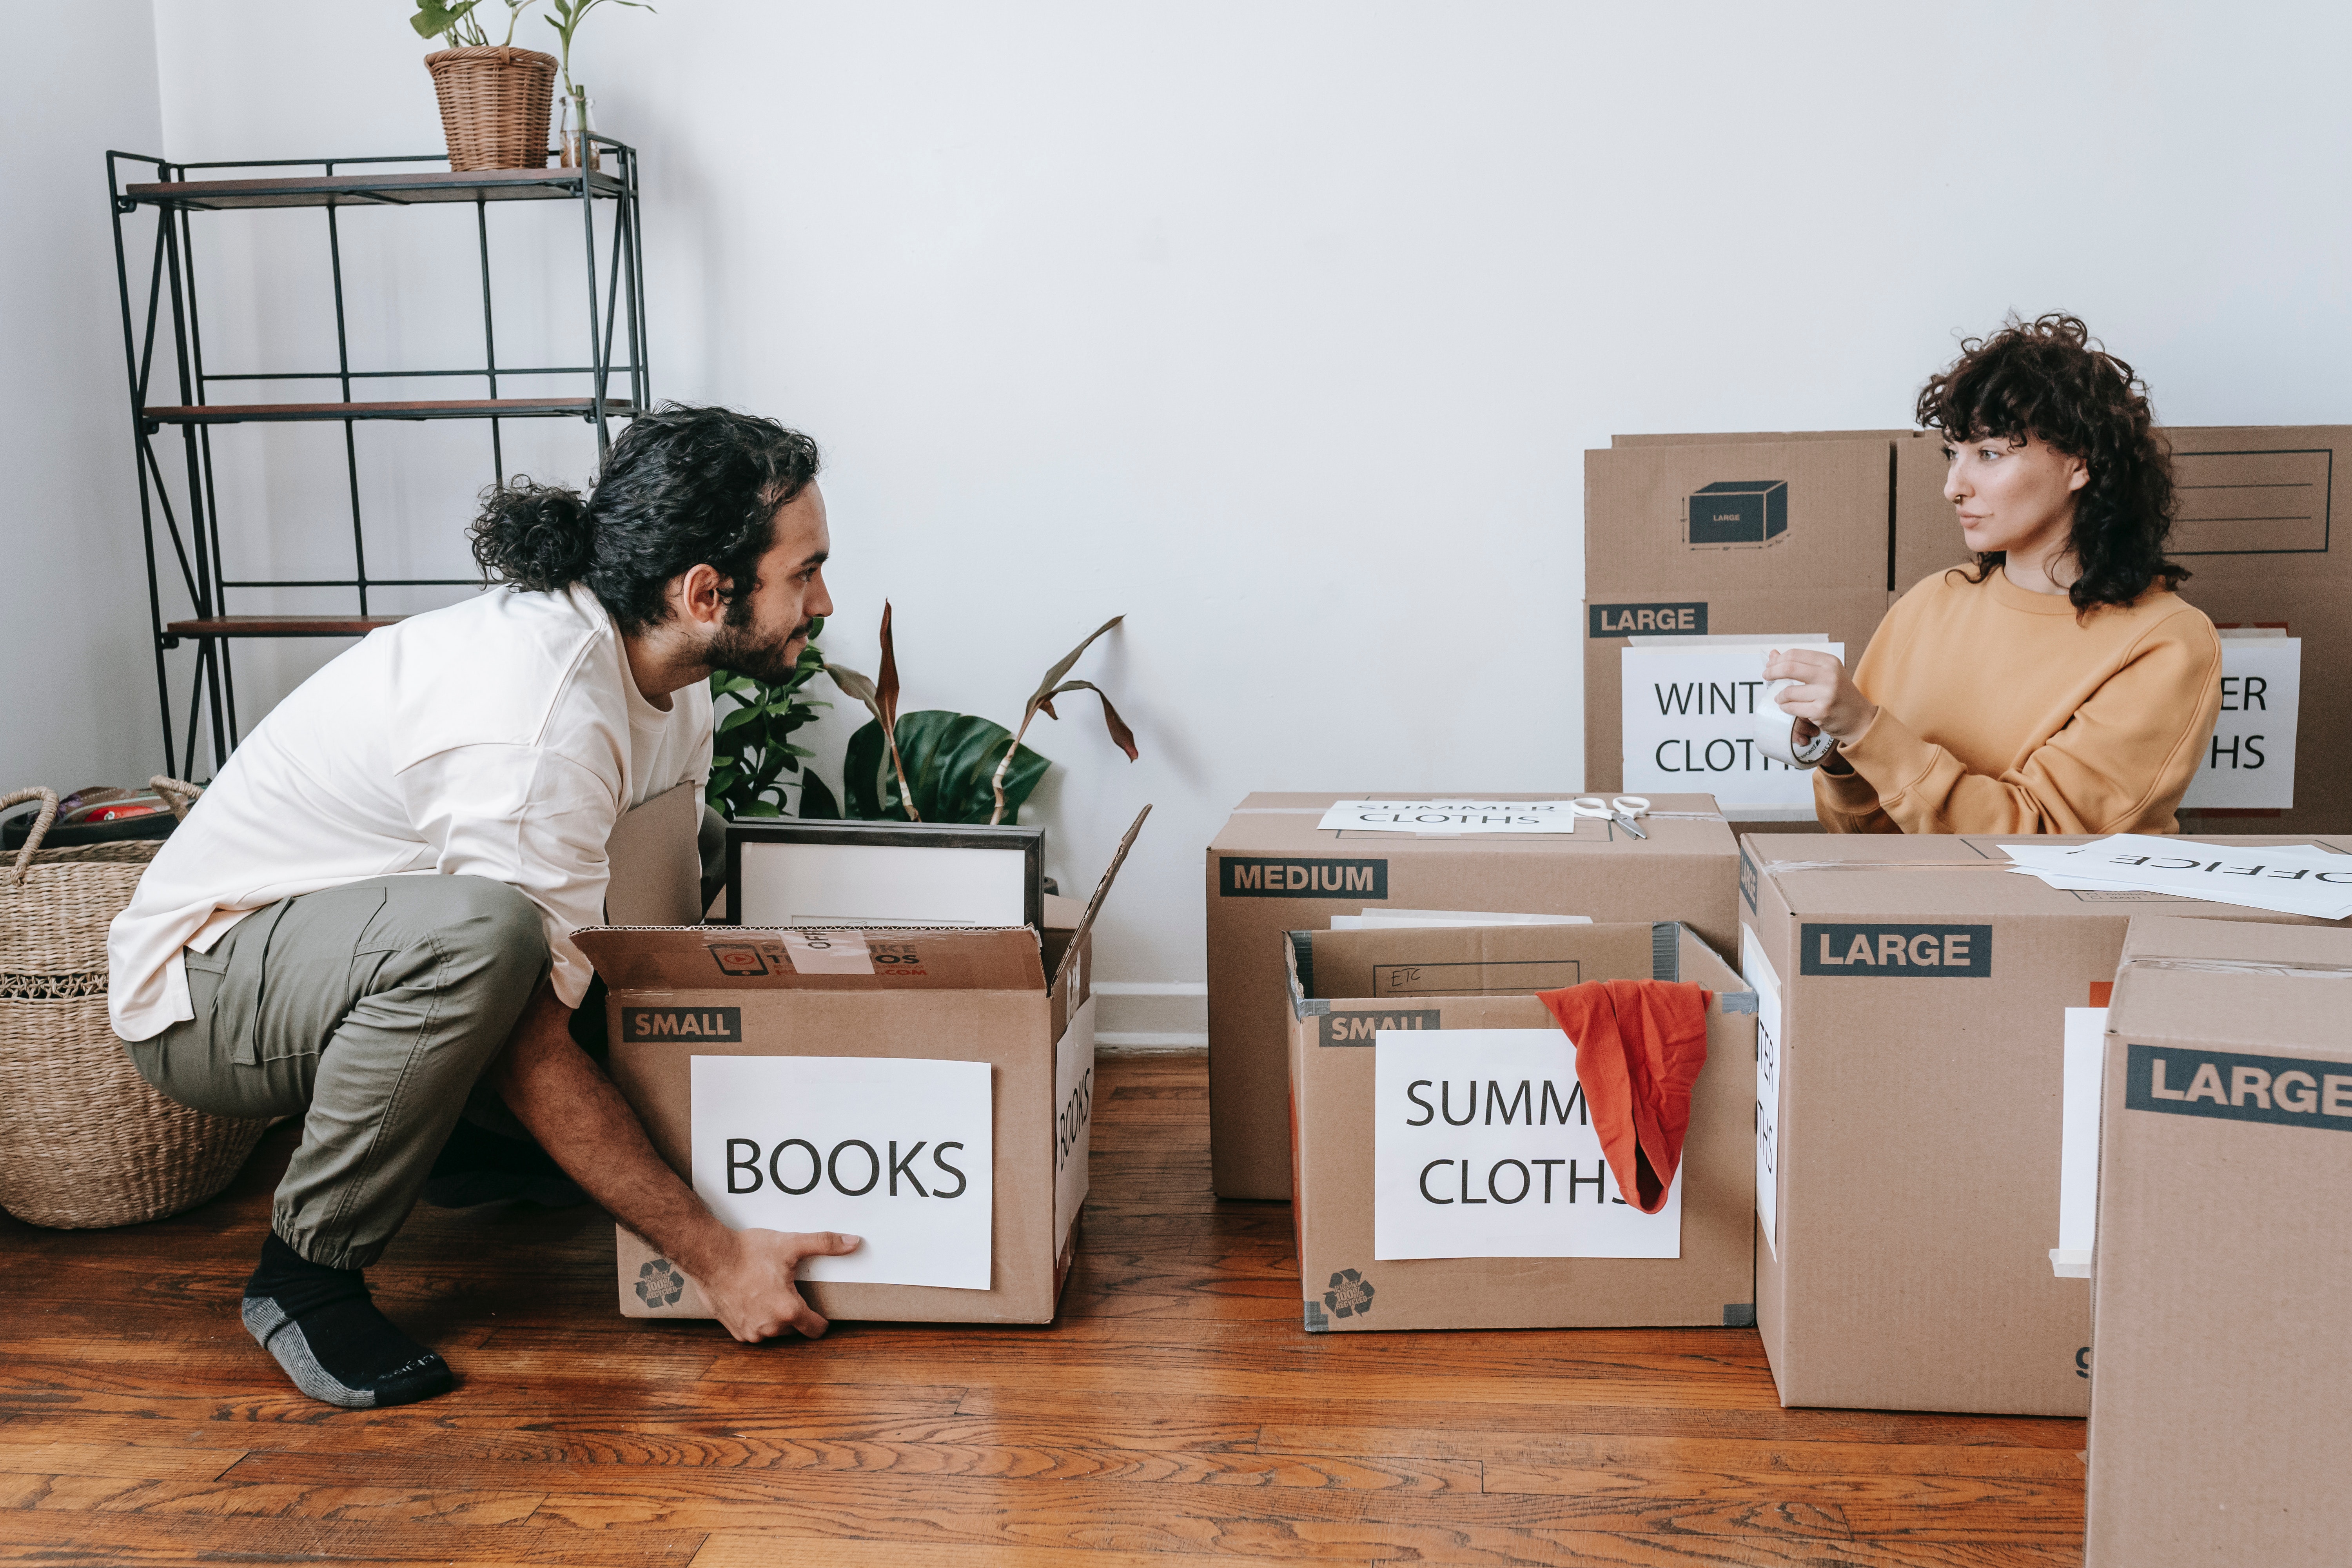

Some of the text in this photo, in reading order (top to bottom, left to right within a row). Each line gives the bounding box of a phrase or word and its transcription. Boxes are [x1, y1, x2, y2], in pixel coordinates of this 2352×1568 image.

[1601, 608, 1695, 631] LARGE
[1655, 681, 1764, 715] WINT
[1656, 739, 1806, 771] CLOT
[1360, 813, 1539, 824] CLOTHS
[1234, 865, 1374, 892] MEDIUM
[1741, 855, 1756, 904] LARGE
[869, 945, 917, 953] IKE
[1820, 933, 1971, 966] LARGE
[1391, 968, 1421, 987] ETC
[635, 1013, 731, 1036] SMALL
[2151, 1059, 2352, 1117] LARGE
[1406, 1080, 1587, 1126] SUMM
[1060, 1067, 1090, 1172] BOOKS
[726, 1138, 967, 1198] BOOKS
[1419, 1159, 1628, 1204] CLOTH
[646, 1277, 674, 1292] 100%
[1335, 1280, 1359, 1293] PRATT
[1335, 1287, 1365, 1302] 100%
[1336, 1296, 1368, 1310] RECYCLED
